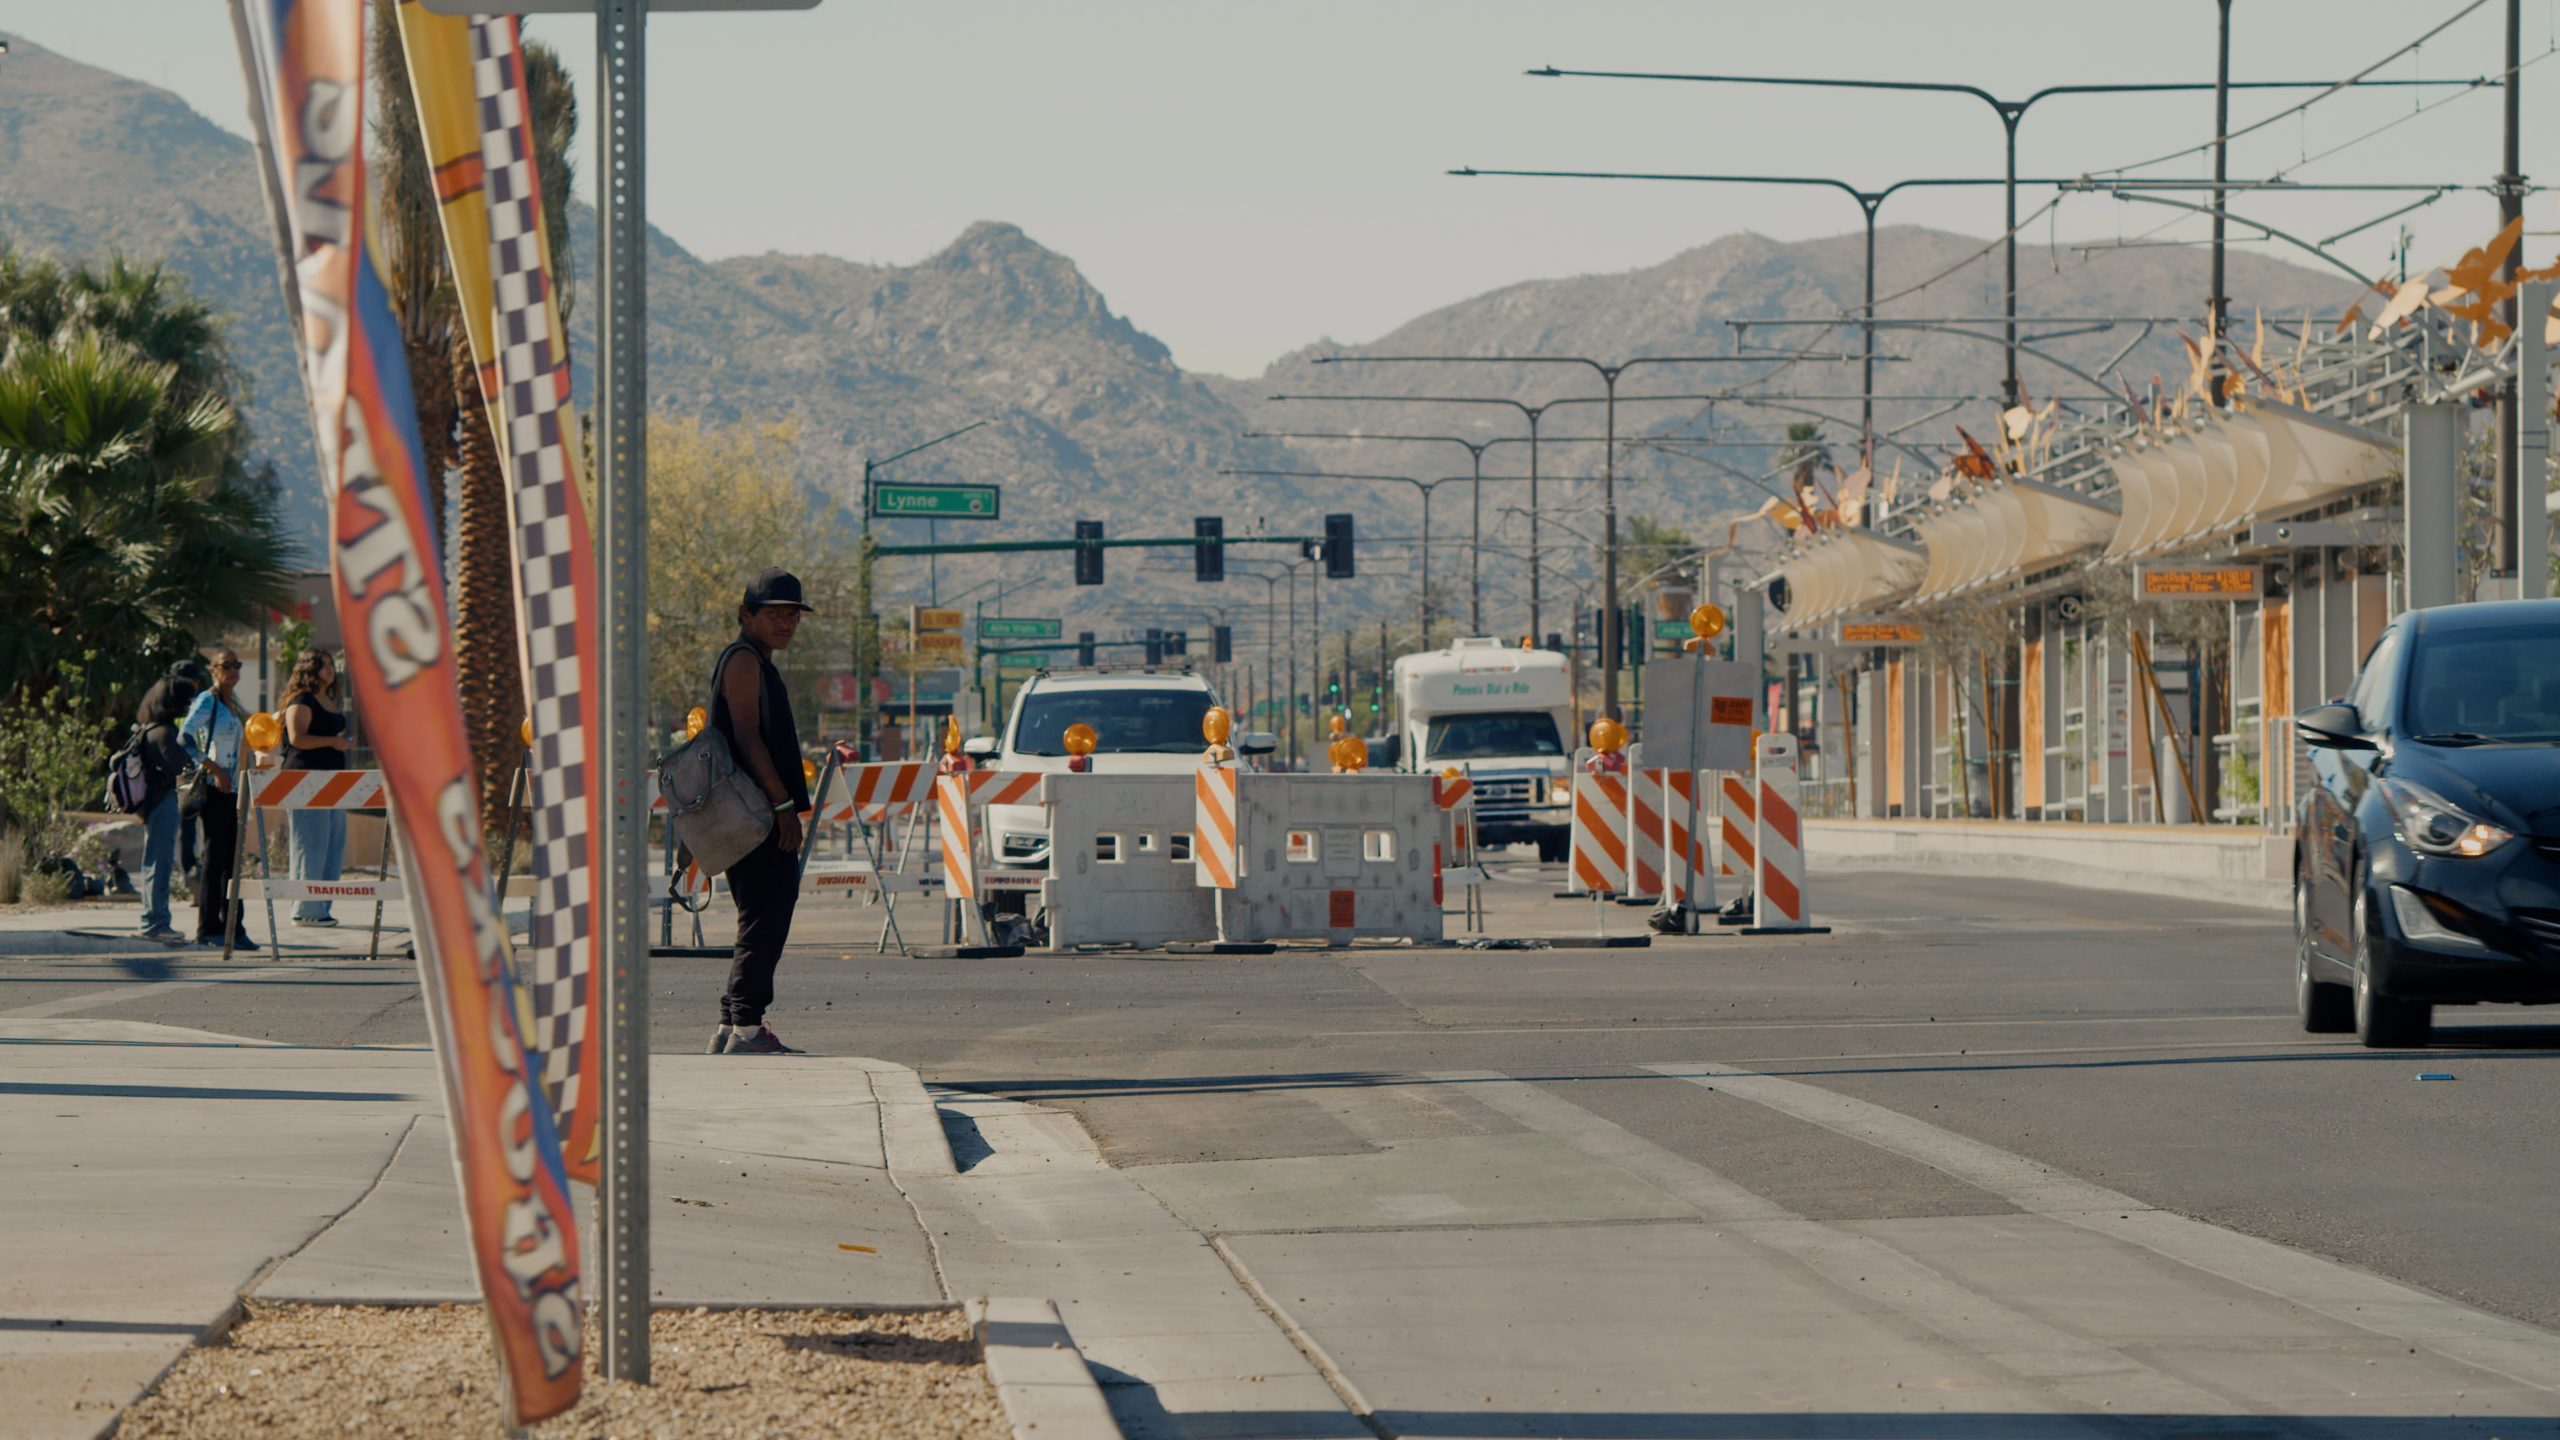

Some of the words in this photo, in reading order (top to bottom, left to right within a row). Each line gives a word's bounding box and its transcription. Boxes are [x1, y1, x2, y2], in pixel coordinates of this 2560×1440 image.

[887, 493, 939, 509] Lynne
[1513, 682, 1530, 694] Ride
[816, 875, 867, 886] TRAFFICADE
[306, 885, 377, 896] TRAFFICADE
